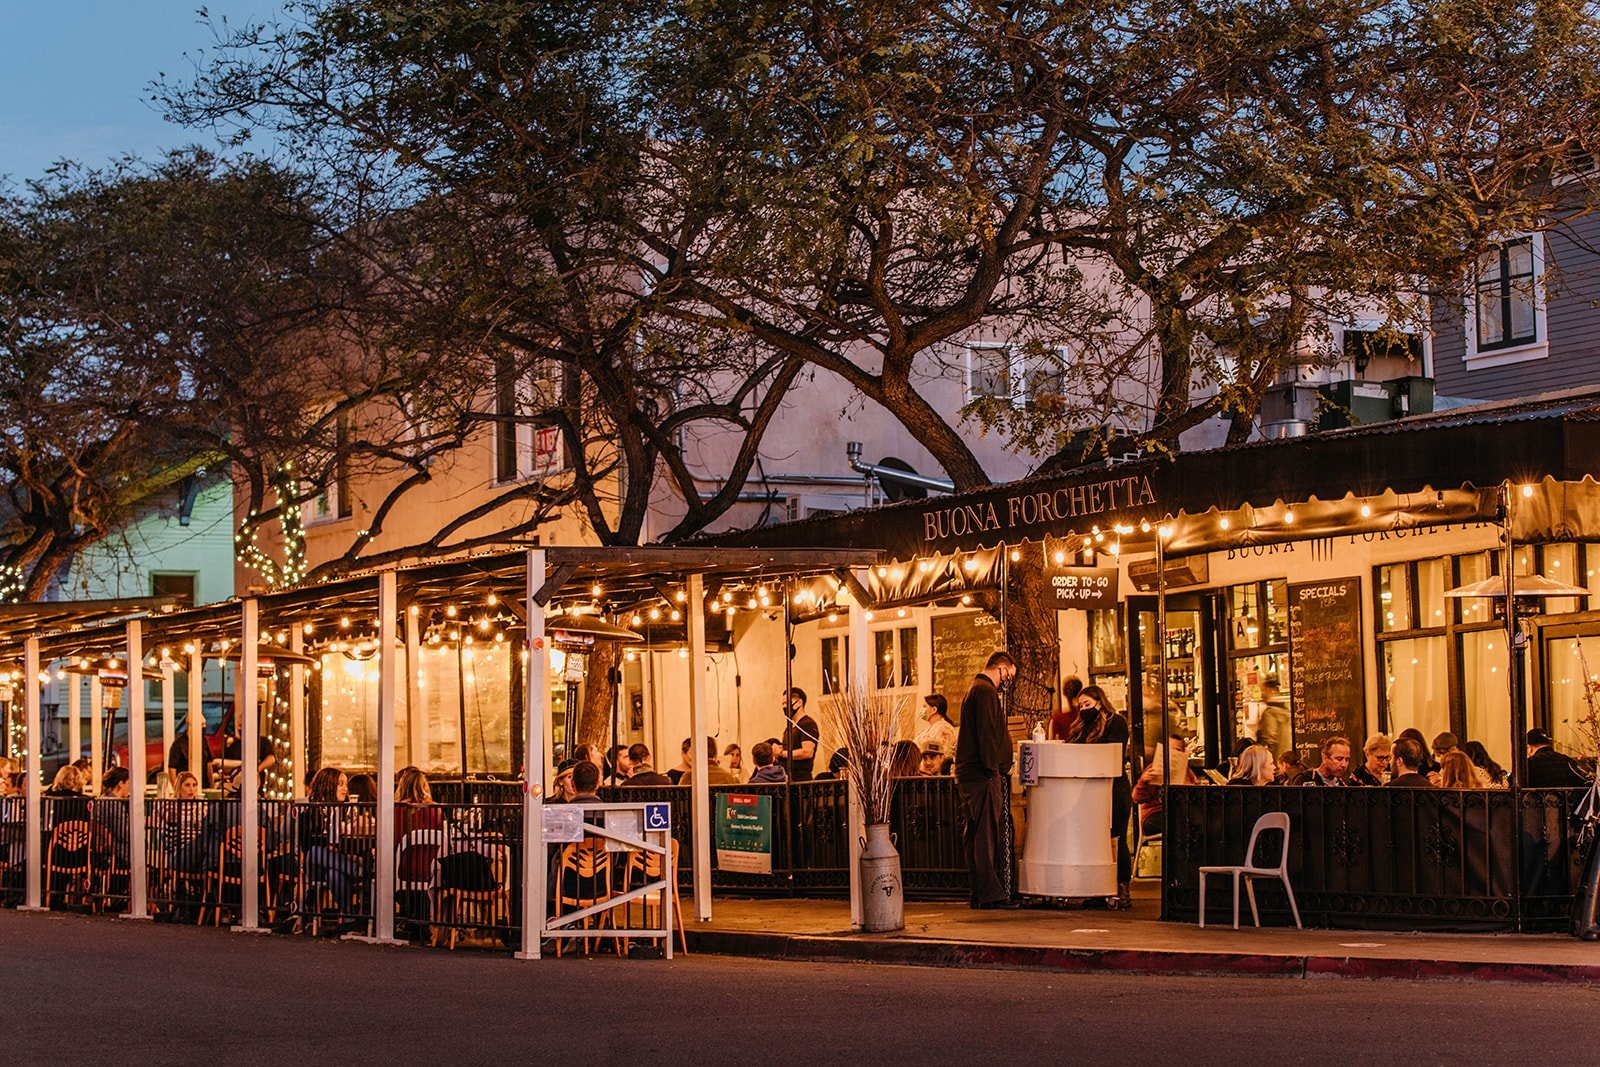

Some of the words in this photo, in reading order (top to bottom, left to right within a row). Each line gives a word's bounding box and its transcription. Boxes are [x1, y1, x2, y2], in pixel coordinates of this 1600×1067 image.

[923, 502, 1001, 541] BUONA
[1007, 475, 1157, 528] FORCHETTA
[1227, 541, 1295, 560] BUONA
[1052, 576, 1078, 587] ORDER
[1081, 576, 1108, 588] TO-GO
[1056, 588, 1091, 599] PICK-UP
[1299, 586, 1347, 600] SPECIALS
[1236, 621, 1246, 638] A
